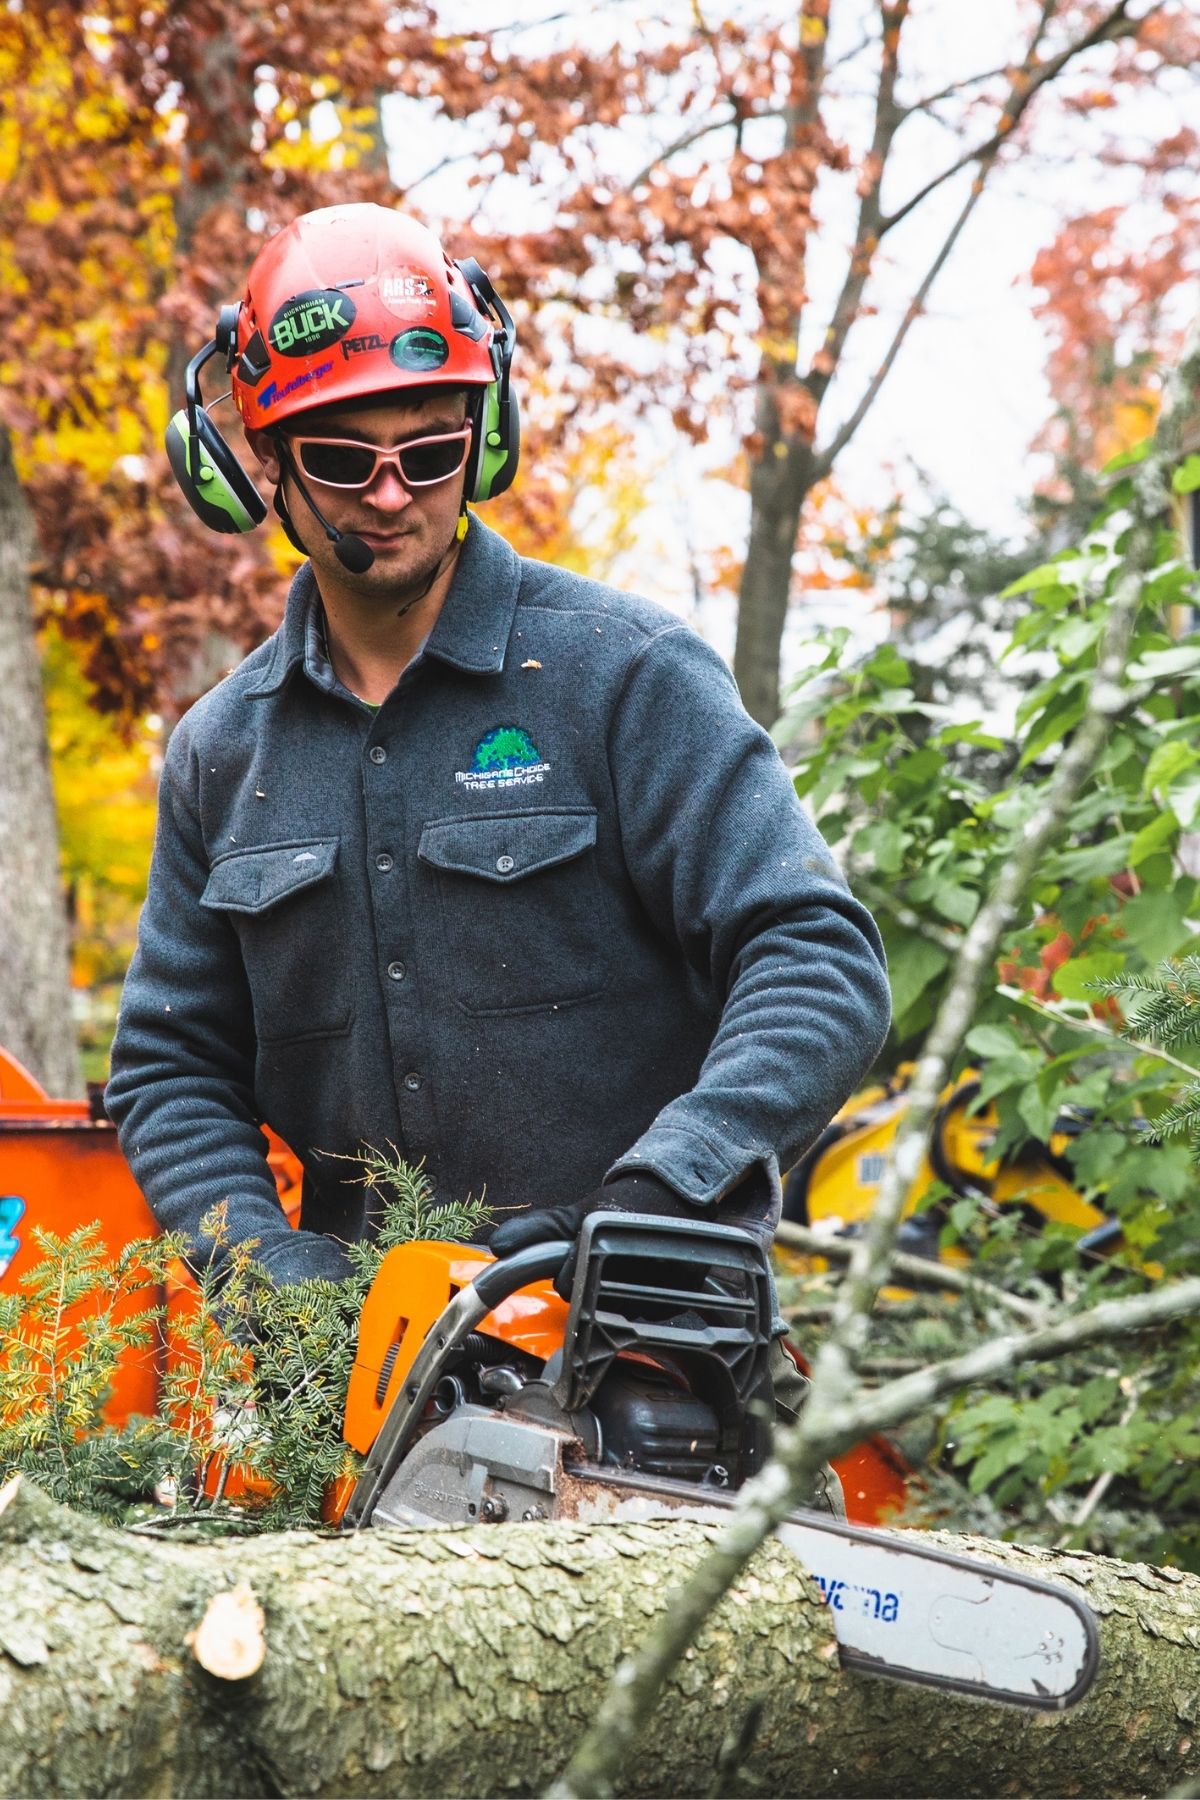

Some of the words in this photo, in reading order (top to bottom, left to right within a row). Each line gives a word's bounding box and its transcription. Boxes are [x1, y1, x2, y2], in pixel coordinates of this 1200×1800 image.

[283, 298, 325, 319] BUCKINGHAM
[273, 298, 350, 352] BUCK
[341, 334, 389, 361] PETZL
[463, 780, 496, 790] TREE
